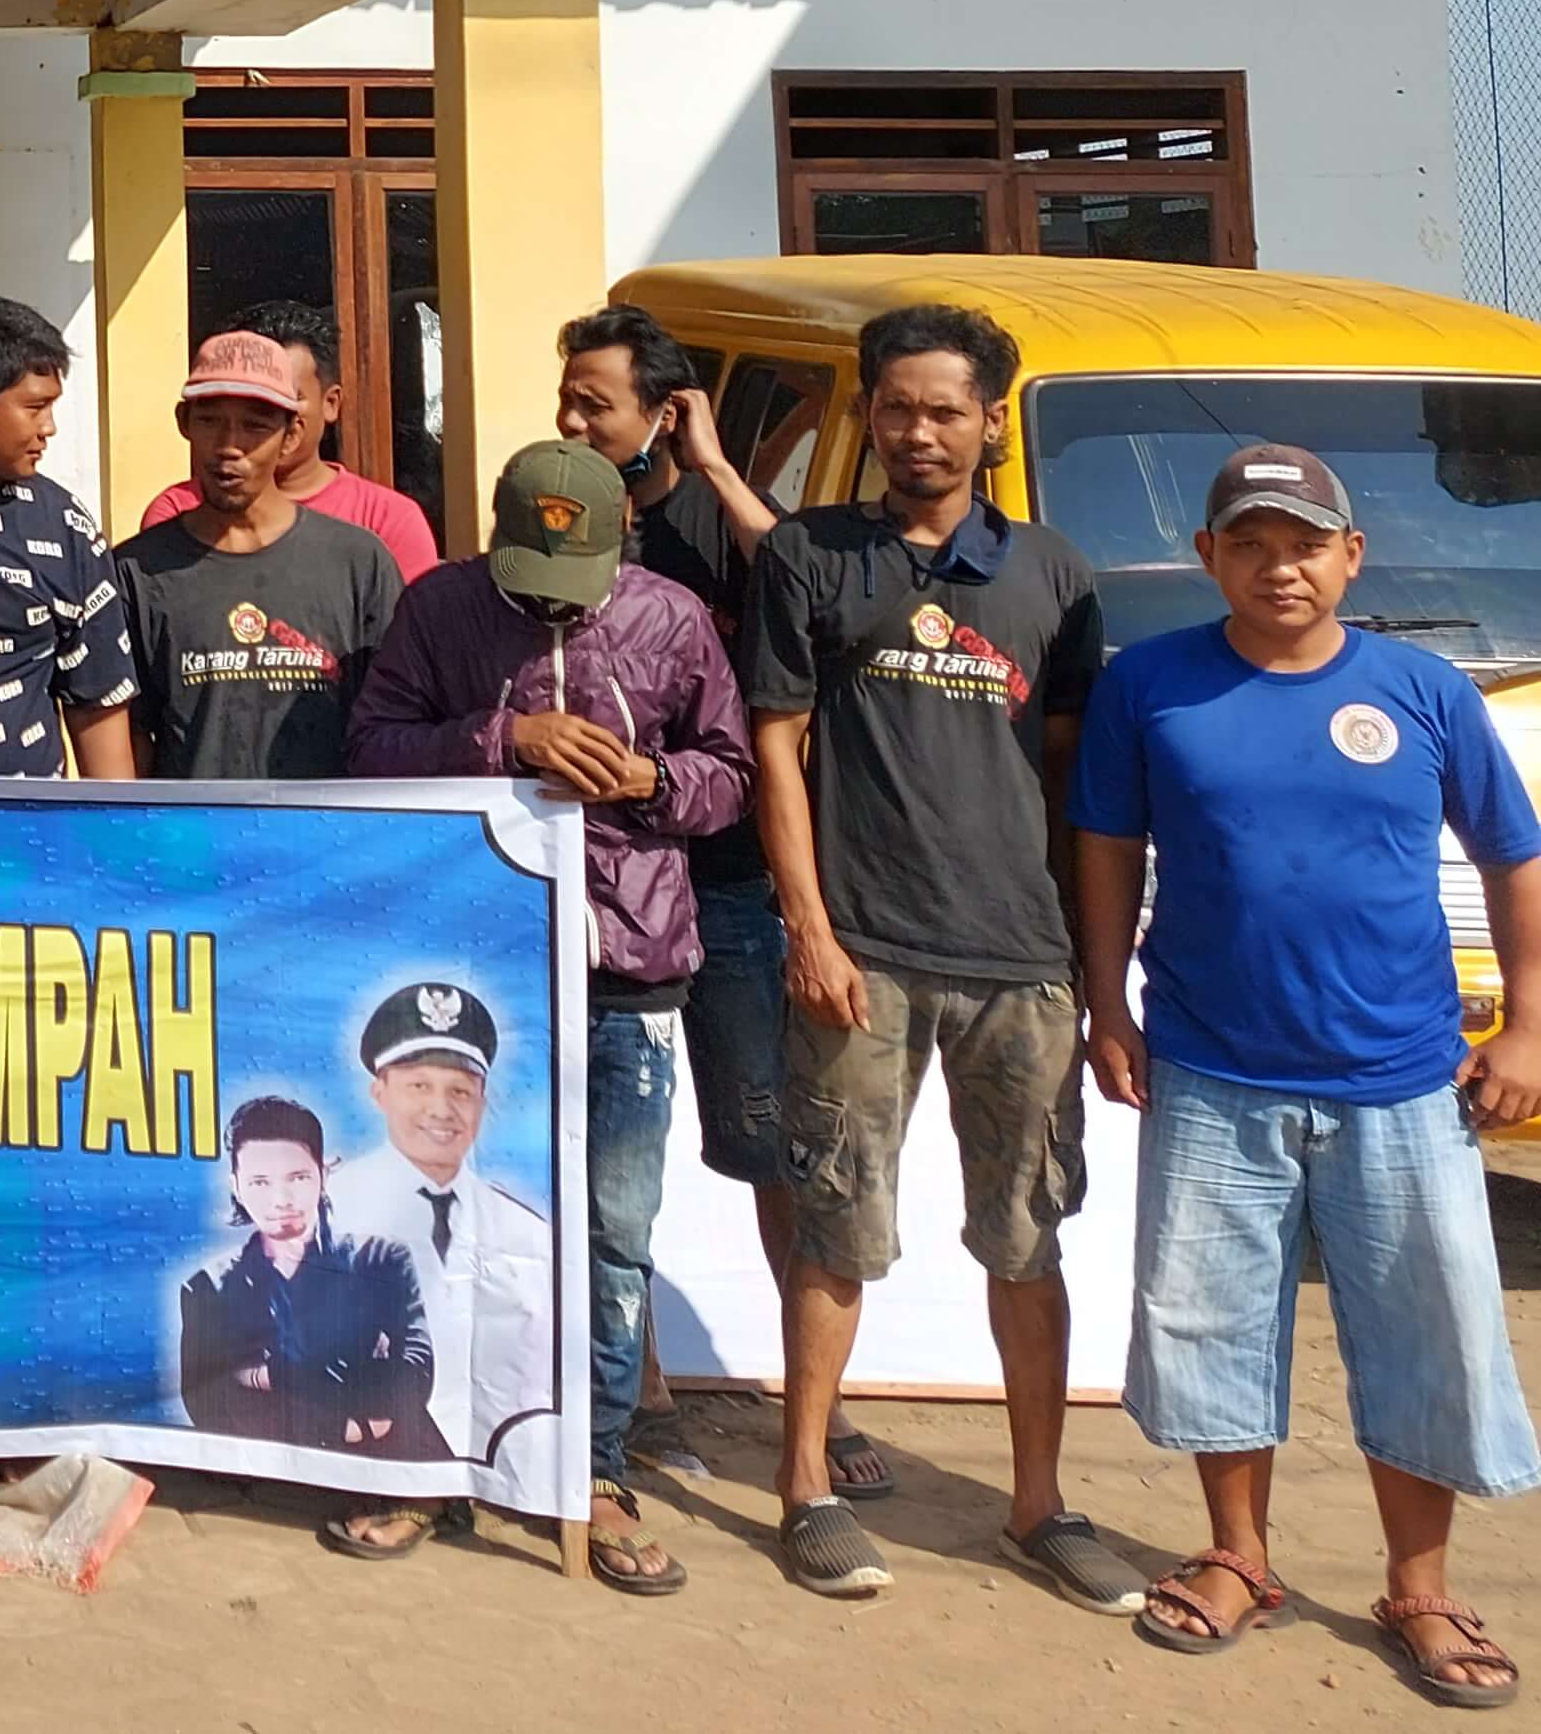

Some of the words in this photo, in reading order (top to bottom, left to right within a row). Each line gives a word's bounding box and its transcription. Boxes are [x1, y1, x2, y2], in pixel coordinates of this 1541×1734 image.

[26, 539, 63, 558] KORG
[181, 650, 250, 674] Karang
[255, 646, 324, 667] Taruna
[933, 652, 1013, 679] Taruna
